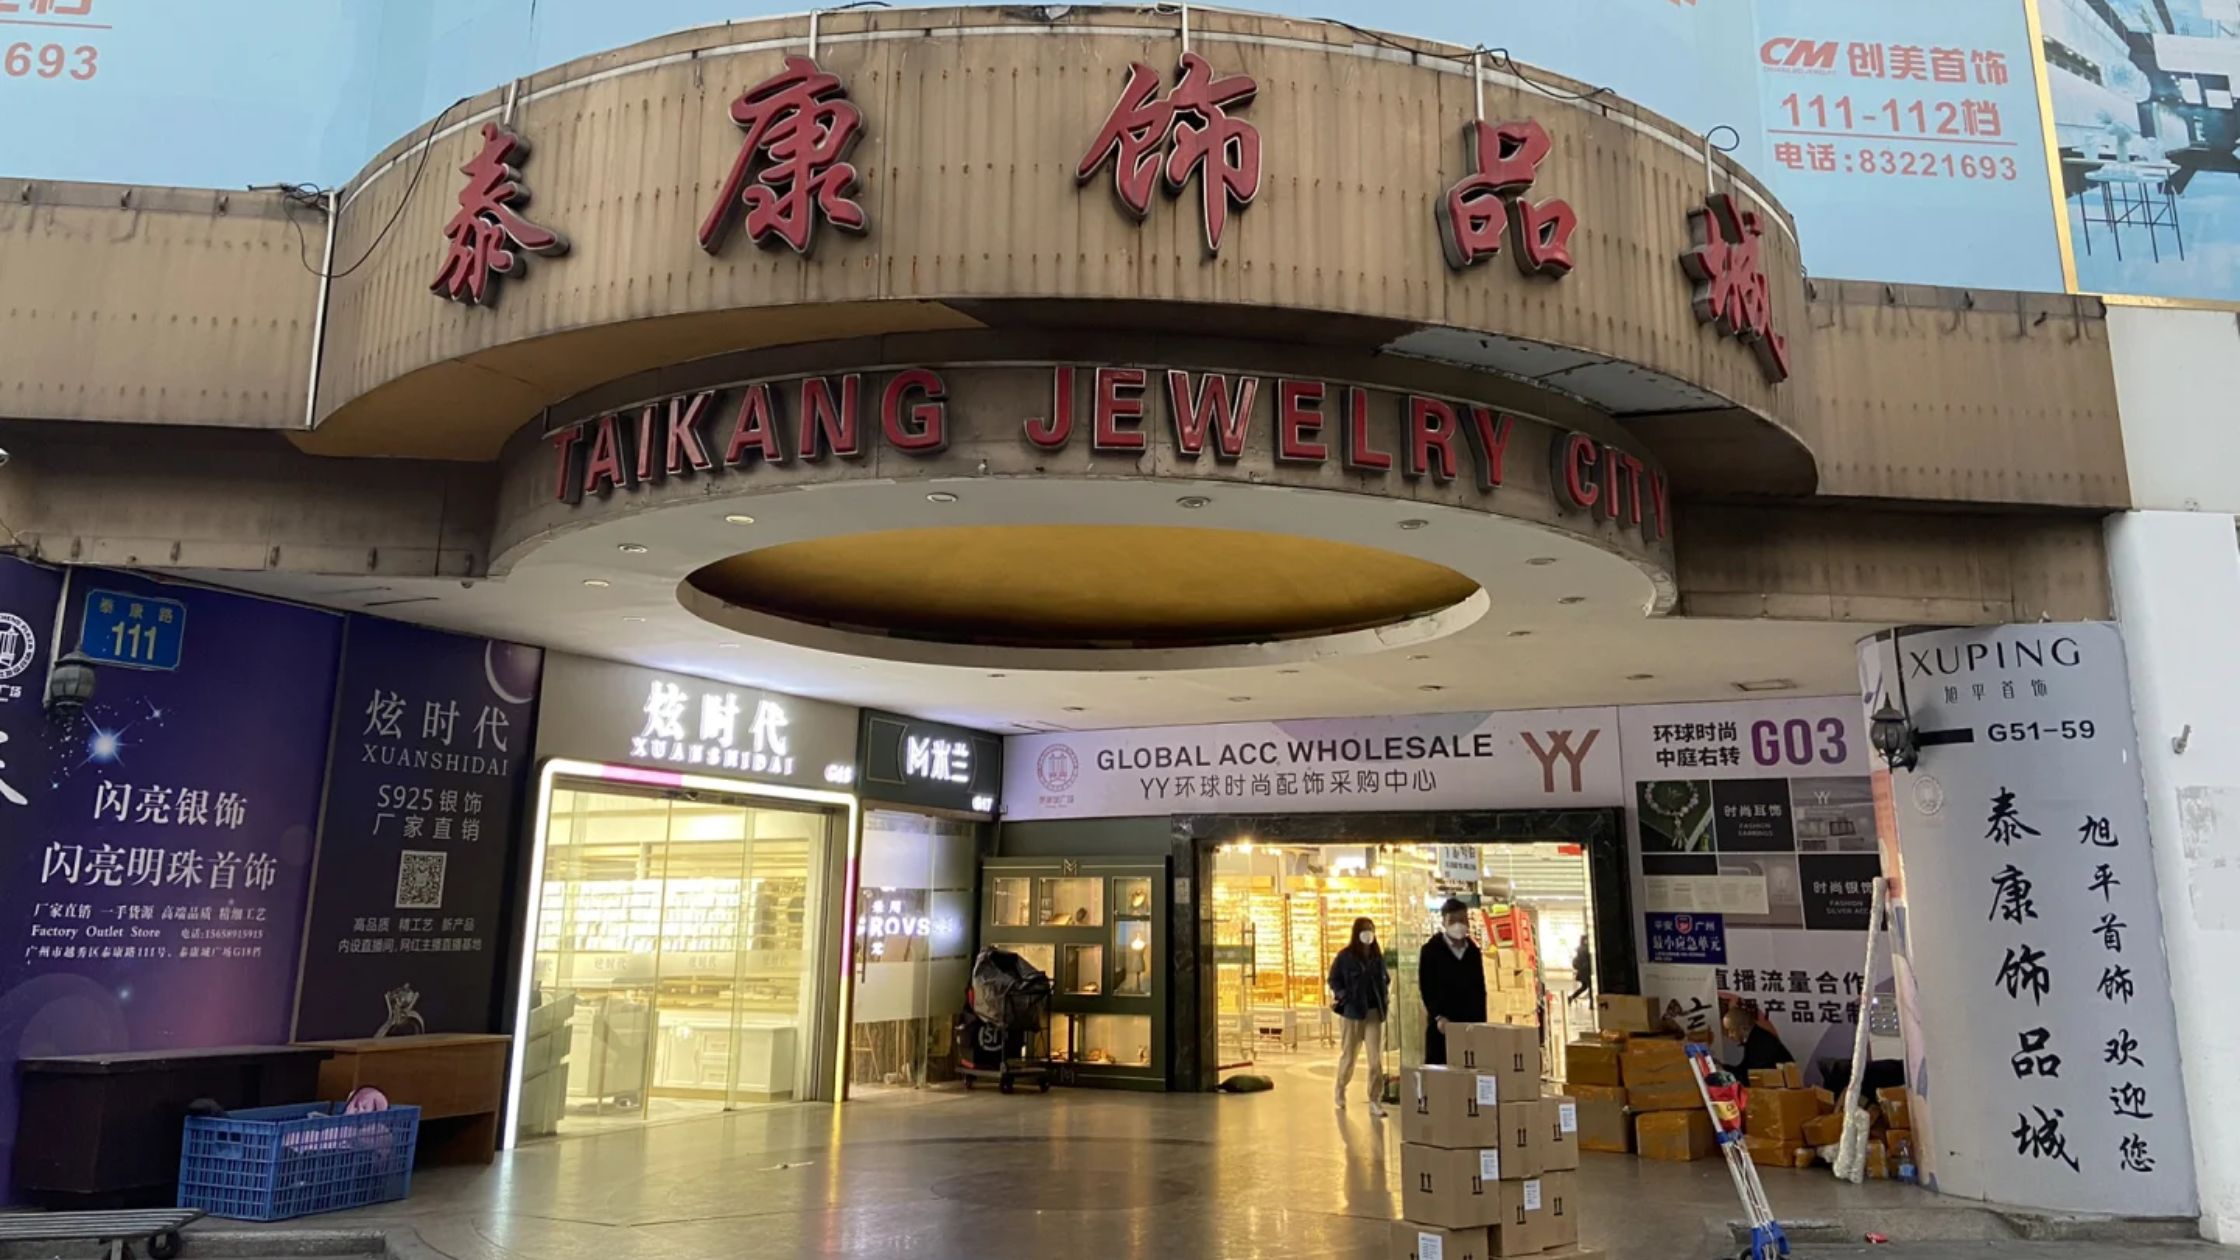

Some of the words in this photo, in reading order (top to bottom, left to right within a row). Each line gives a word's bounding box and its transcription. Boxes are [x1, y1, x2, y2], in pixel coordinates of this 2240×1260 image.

[4, 41, 98, 81] 693
[1760, 37, 1839, 67] CM
[1847, 42, 2009, 86] 创美首饰
[1780, 92, 2002, 137] 111-112档
[1774, 143, 2017, 181] 电话:83221693
[552, 369, 948, 502] TAIKANG
[1024, 366, 1515, 490] JEWELRY
[1554, 430, 1668, 541] CITY
[112, 620, 158, 661] 111
[1909, 637, 2082, 679] XUPING
[1944, 678, 2049, 704] 旭平首饰
[362, 689, 511, 753] 炫时代
[642, 680, 790, 756] 炫时代
[1653, 722, 1737, 743] 环球时尚
[1987, 719, 2096, 743] G51-59
[361, 743, 509, 777] XUANSHIDAI
[630, 735, 794, 776] XUANSHIDAI
[1096, 746, 1211, 771] GLOBAL
[1218, 742, 1278, 766] ACC
[1287, 733, 1494, 764] WHOLESALE
[1656, 747, 1741, 768] 中庭右转
[1751, 717, 1848, 767] G03
[1139, 767, 1437, 800] YY环球时尚配饰采购中心
[94, 779, 248, 830] 闪亮银饰
[372, 813, 481, 843] 厂家直销
[41, 841, 278, 892] 闪亮明珠首饰
[33, 902, 92, 920] 厂家直销
[31, 924, 78, 941] Factory
[86, 925, 123, 938] Outlet
[130, 926, 161, 938] Store
[1984, 786, 2080, 1172] 泰康饰品城
